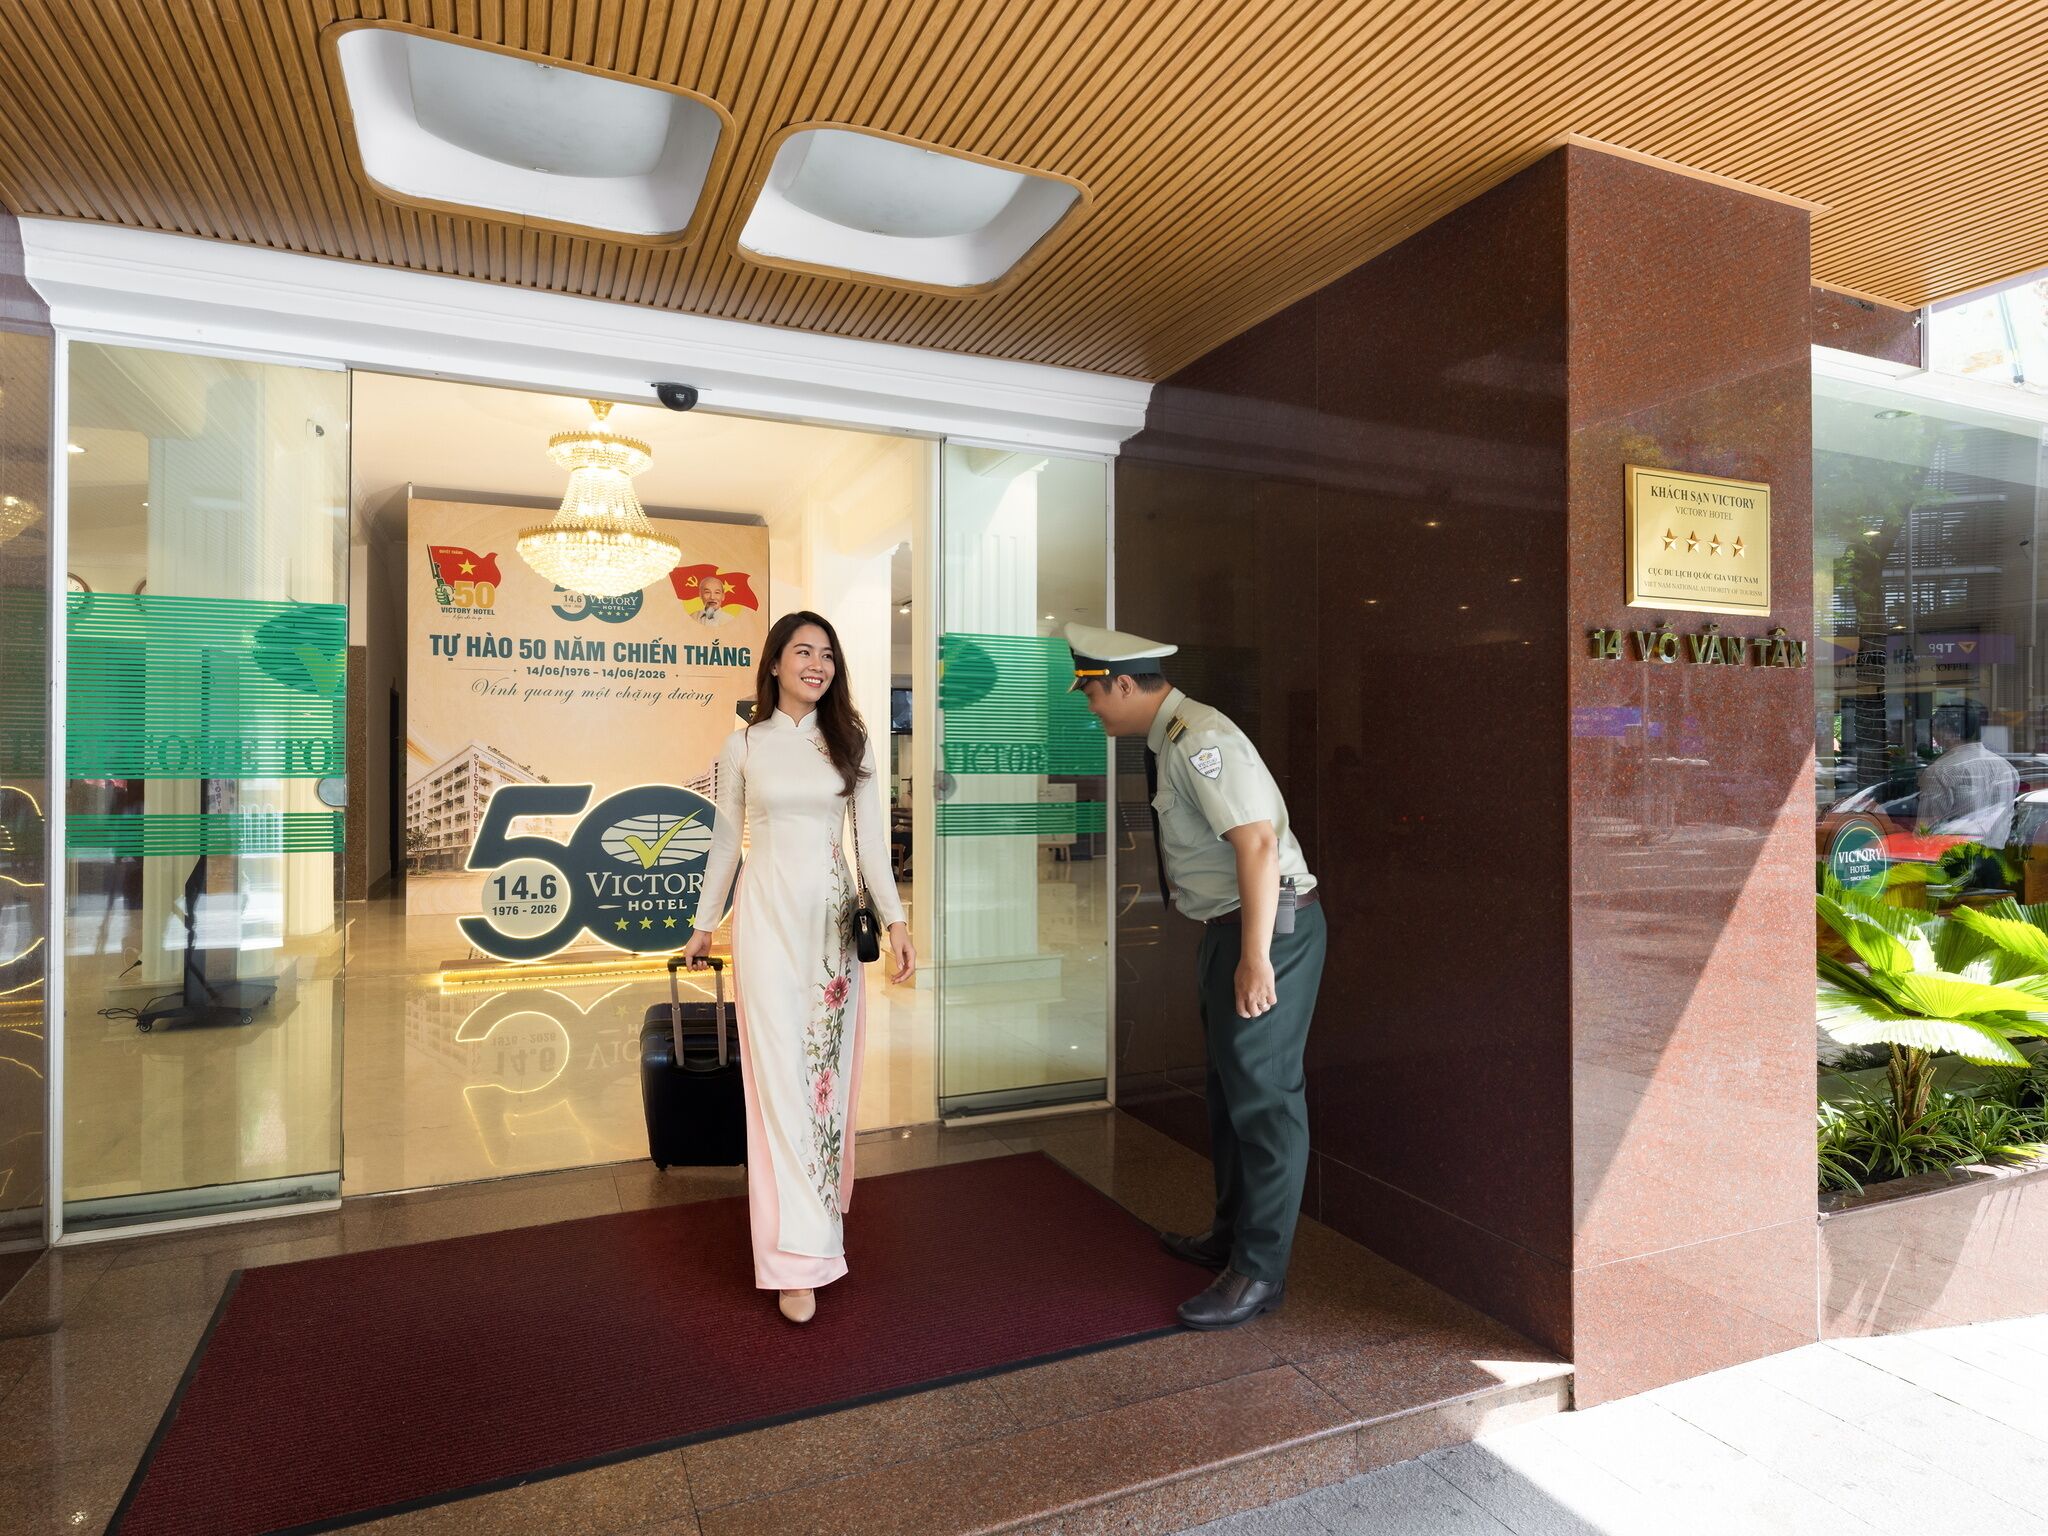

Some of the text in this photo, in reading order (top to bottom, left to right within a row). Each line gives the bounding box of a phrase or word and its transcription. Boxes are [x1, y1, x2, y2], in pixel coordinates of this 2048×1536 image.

[1650, 484, 1755, 509] KHÁCH SẠN VICTORY
[1674, 506, 1733, 521] VICTORY HOTEL
[1664, 568, 1673, 576] DU
[1713, 573, 1726, 581] GIA
[1744, 576, 1759, 584] NAM
[454, 580, 495, 609] 50
[1671, 582, 1699, 591] NATIONAL
[589, 594, 639, 606] VICTORY
[441, 606, 471, 614] VICTORY
[429, 631, 751, 667] TỰ HÀO 50 NĂM CHIẾN THẮNG
[1591, 628, 1623, 660] 14
[526, 664, 590, 677] 14/06/1976
[602, 667, 666, 680] 14/06/2026
[471, 677, 714, 707] Vinh quang một chặng đường
[1838, 848, 1882, 863] VICTORY
[1850, 864, 1871, 874] HOTEL
[493, 875, 557, 900] 14.6
[586, 869, 706, 898] VICTOR
[492, 905, 518, 916] 1976
[531, 904, 557, 915] 2026
[628, 900, 687, 912] HOTEL
